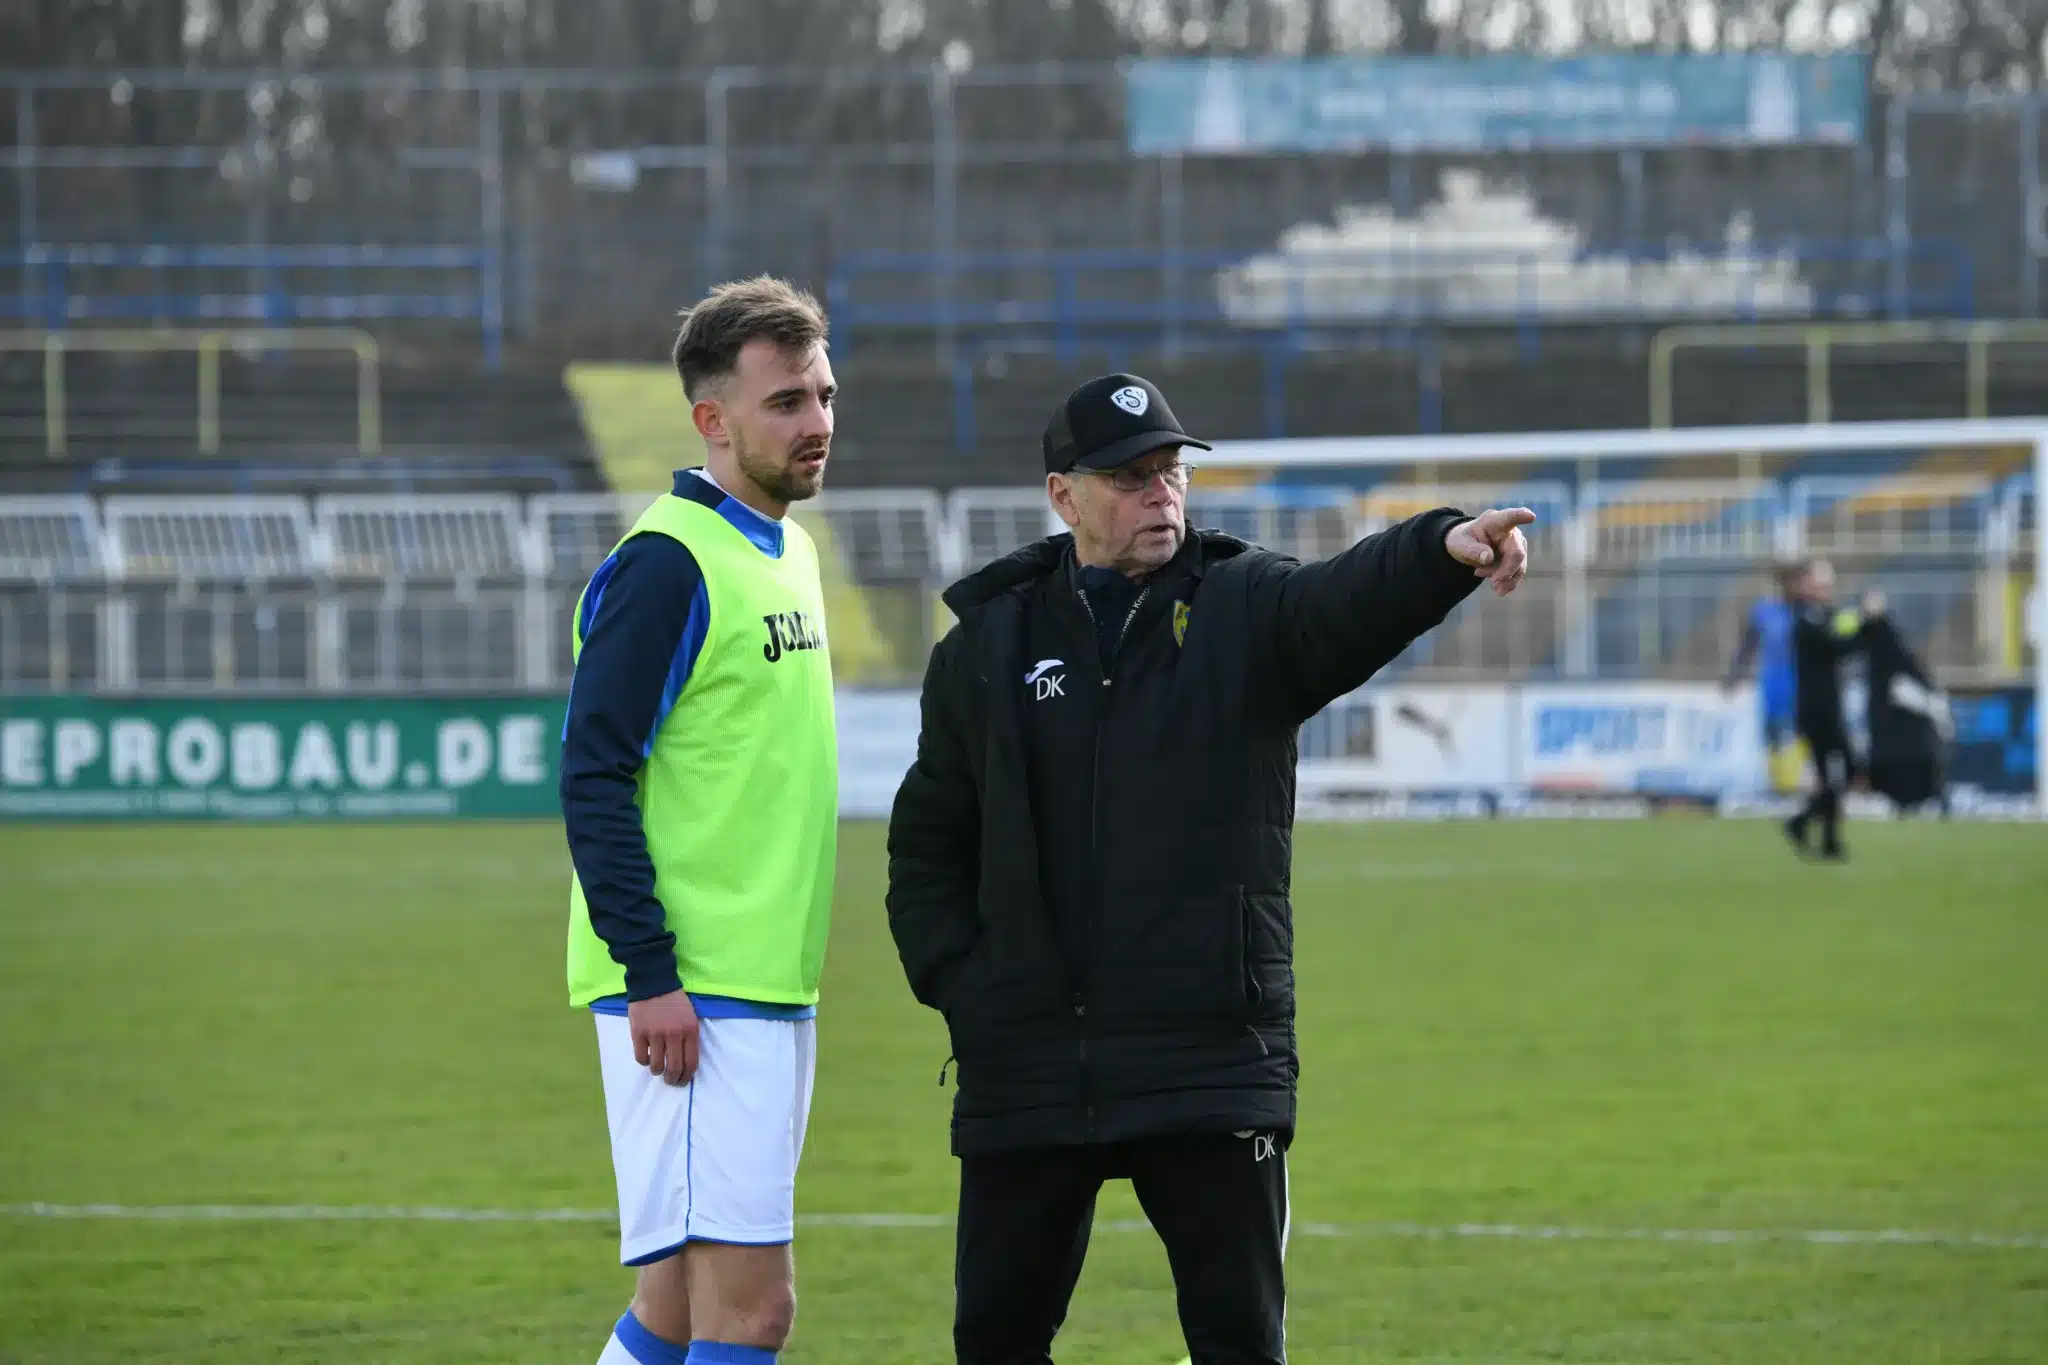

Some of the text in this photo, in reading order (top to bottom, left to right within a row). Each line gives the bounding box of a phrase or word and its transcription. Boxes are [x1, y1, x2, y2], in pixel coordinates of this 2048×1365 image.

[1115, 388, 1144, 408] FSV
[1036, 674, 1067, 701] DK
[1, 713, 547, 790] EPROBAU.DE
[1254, 1131, 1276, 1162] DK
